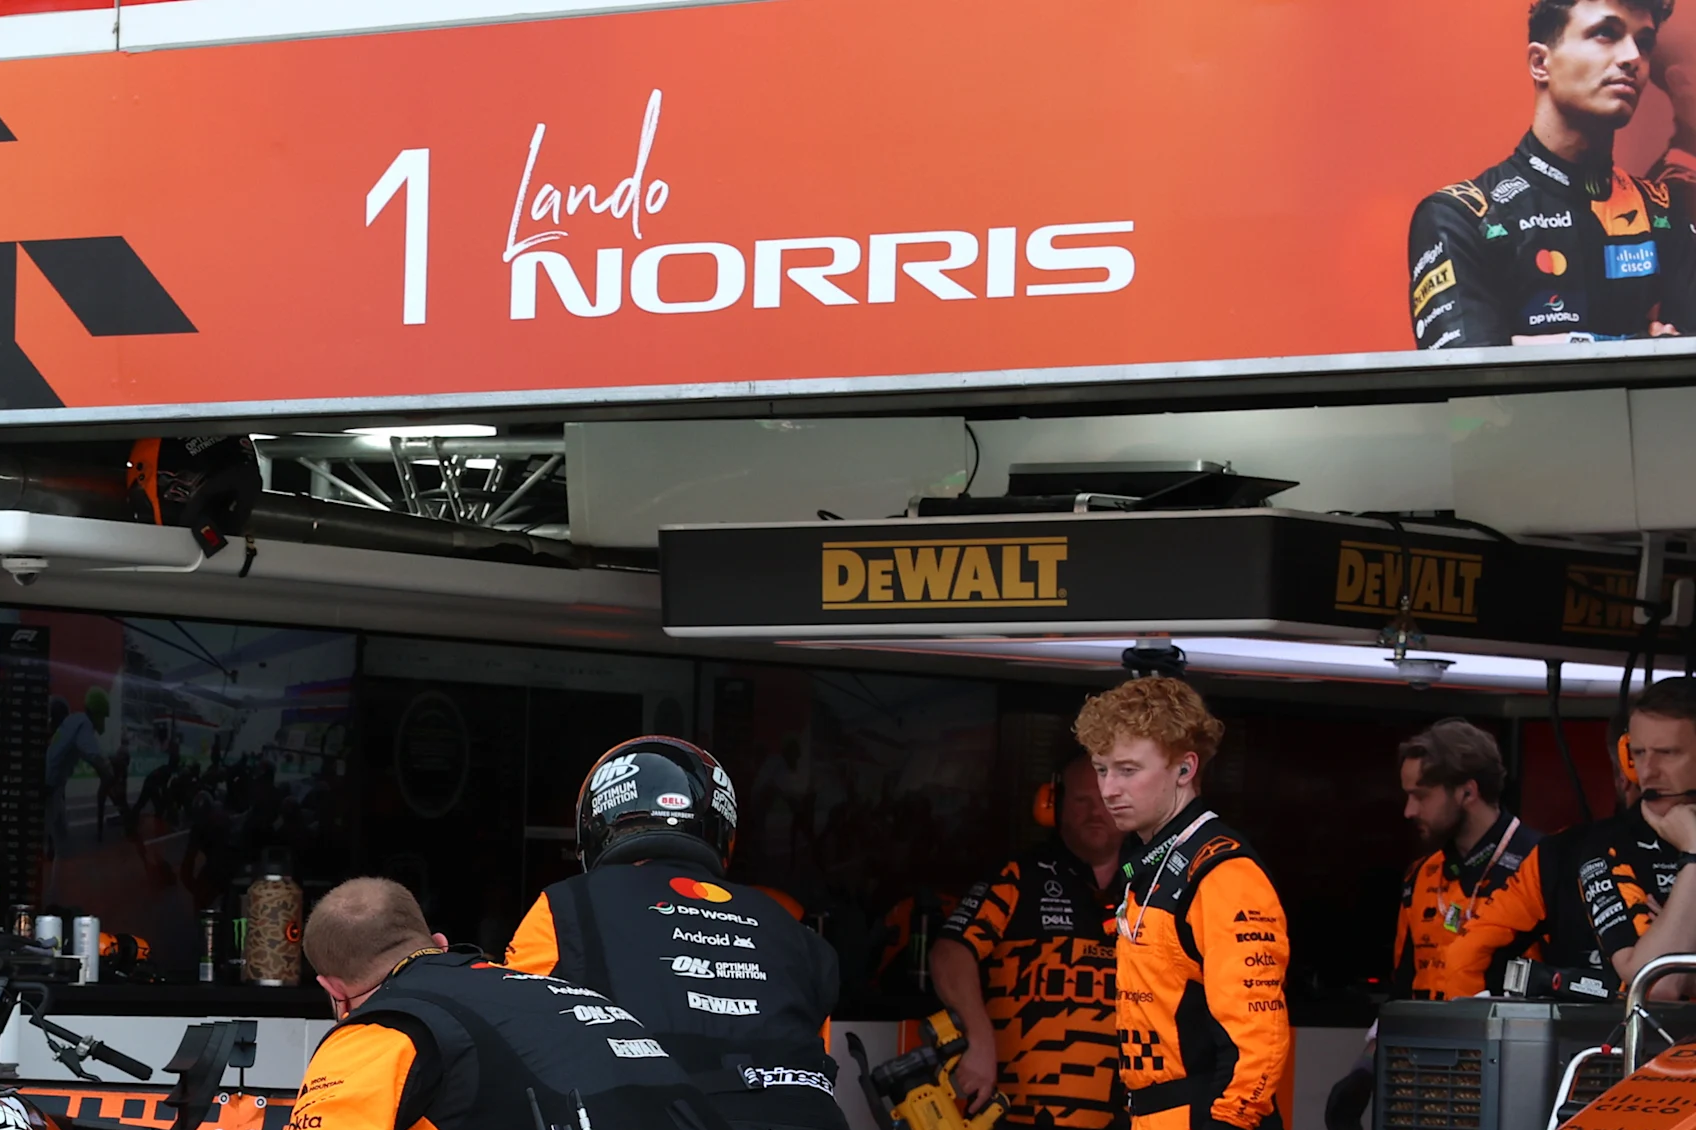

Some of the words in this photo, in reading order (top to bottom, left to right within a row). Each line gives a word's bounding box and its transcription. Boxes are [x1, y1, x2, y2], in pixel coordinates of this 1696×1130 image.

[503, 89, 670, 262] Lando
[1519, 211, 1572, 231] Android
[366, 148, 429, 325] 1
[510, 220, 1135, 320] NORRIS
[1529, 313, 1544, 326] DP
[1546, 311, 1579, 324] WORLD
[592, 780, 636, 808] OPTIMUM
[592, 790, 638, 817] NUTRITION
[661, 797, 686, 805] BELL
[677, 904, 700, 919] DP
[701, 908, 759, 928] WORLD
[672, 927, 731, 948] Android
[715, 962, 760, 974] OPTIMUM
[1244, 953, 1276, 967] okta
[716, 969, 767, 981] NUTRITION
[688, 991, 760, 1016] DEWALT
[1595, 1104, 1681, 1114] CISCO
